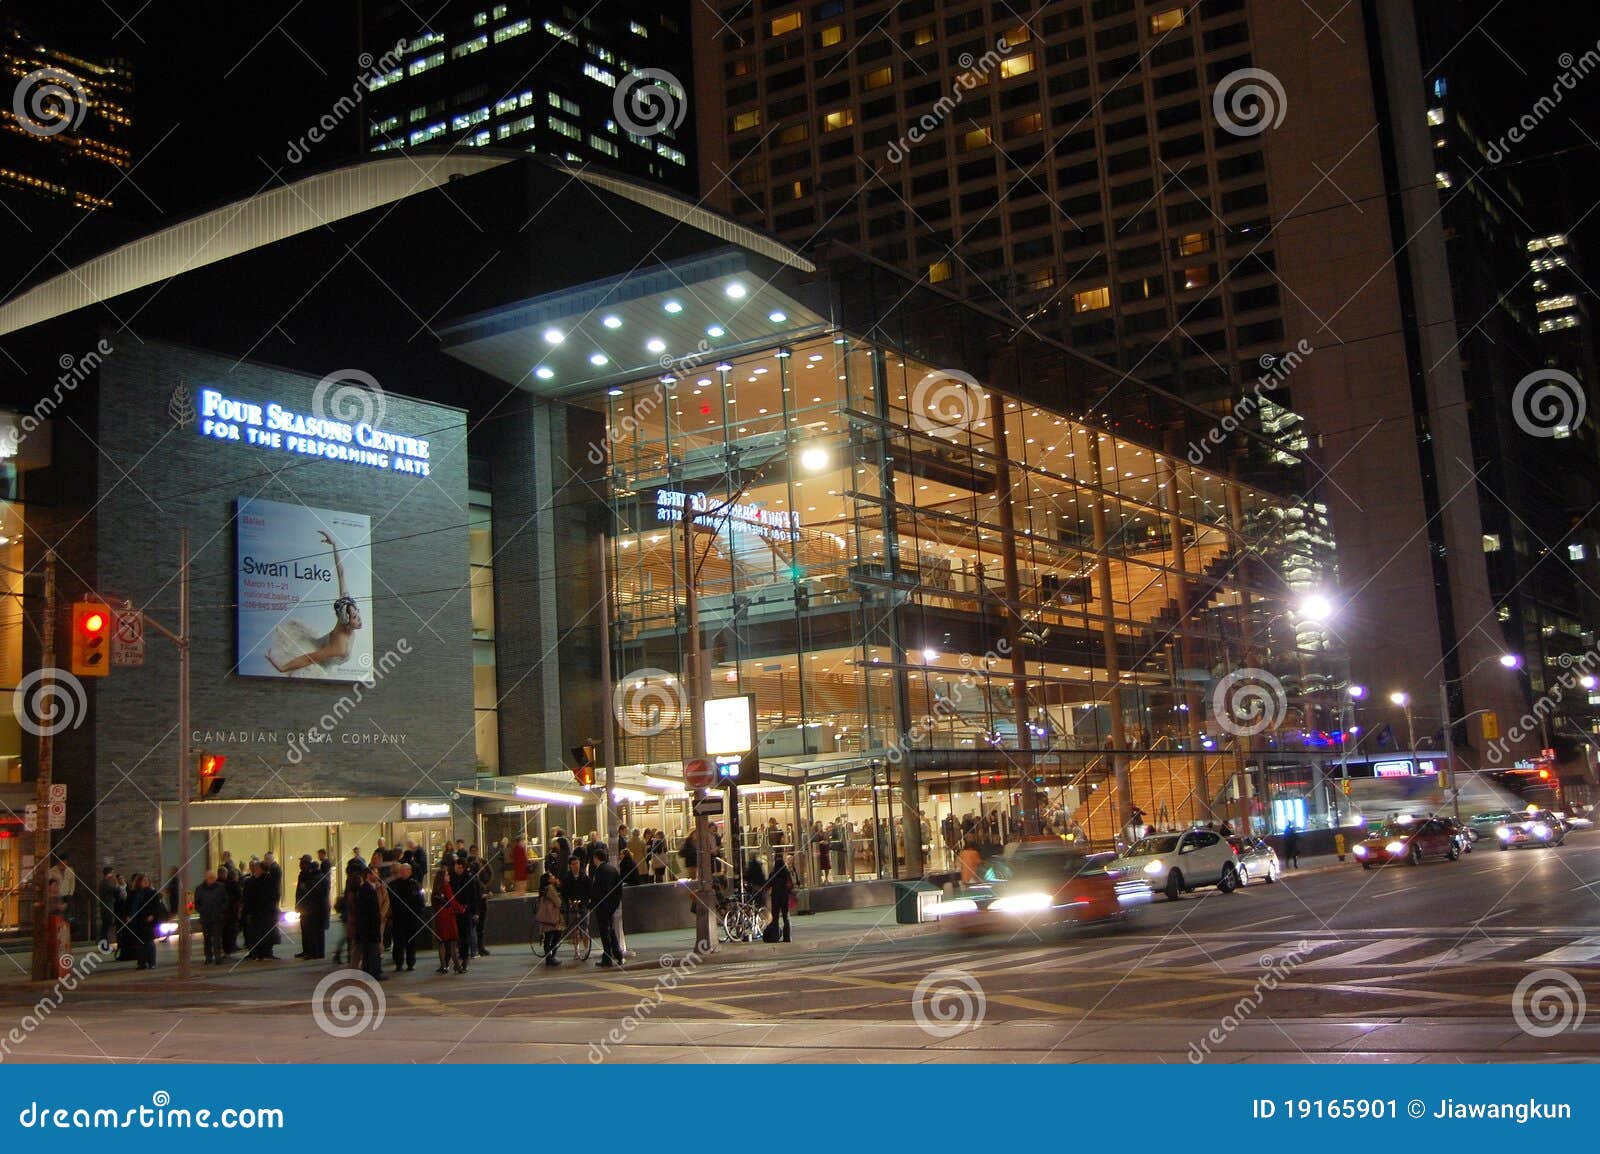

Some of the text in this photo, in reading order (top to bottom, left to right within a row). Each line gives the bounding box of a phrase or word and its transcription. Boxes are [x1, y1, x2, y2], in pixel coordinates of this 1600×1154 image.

[203, 420, 430, 476] FOR THE PERFORMING ARTS
[242, 556, 331, 582] Swan Lake
[192, 731, 408, 745] CANADIAN OPERA COMPANY
